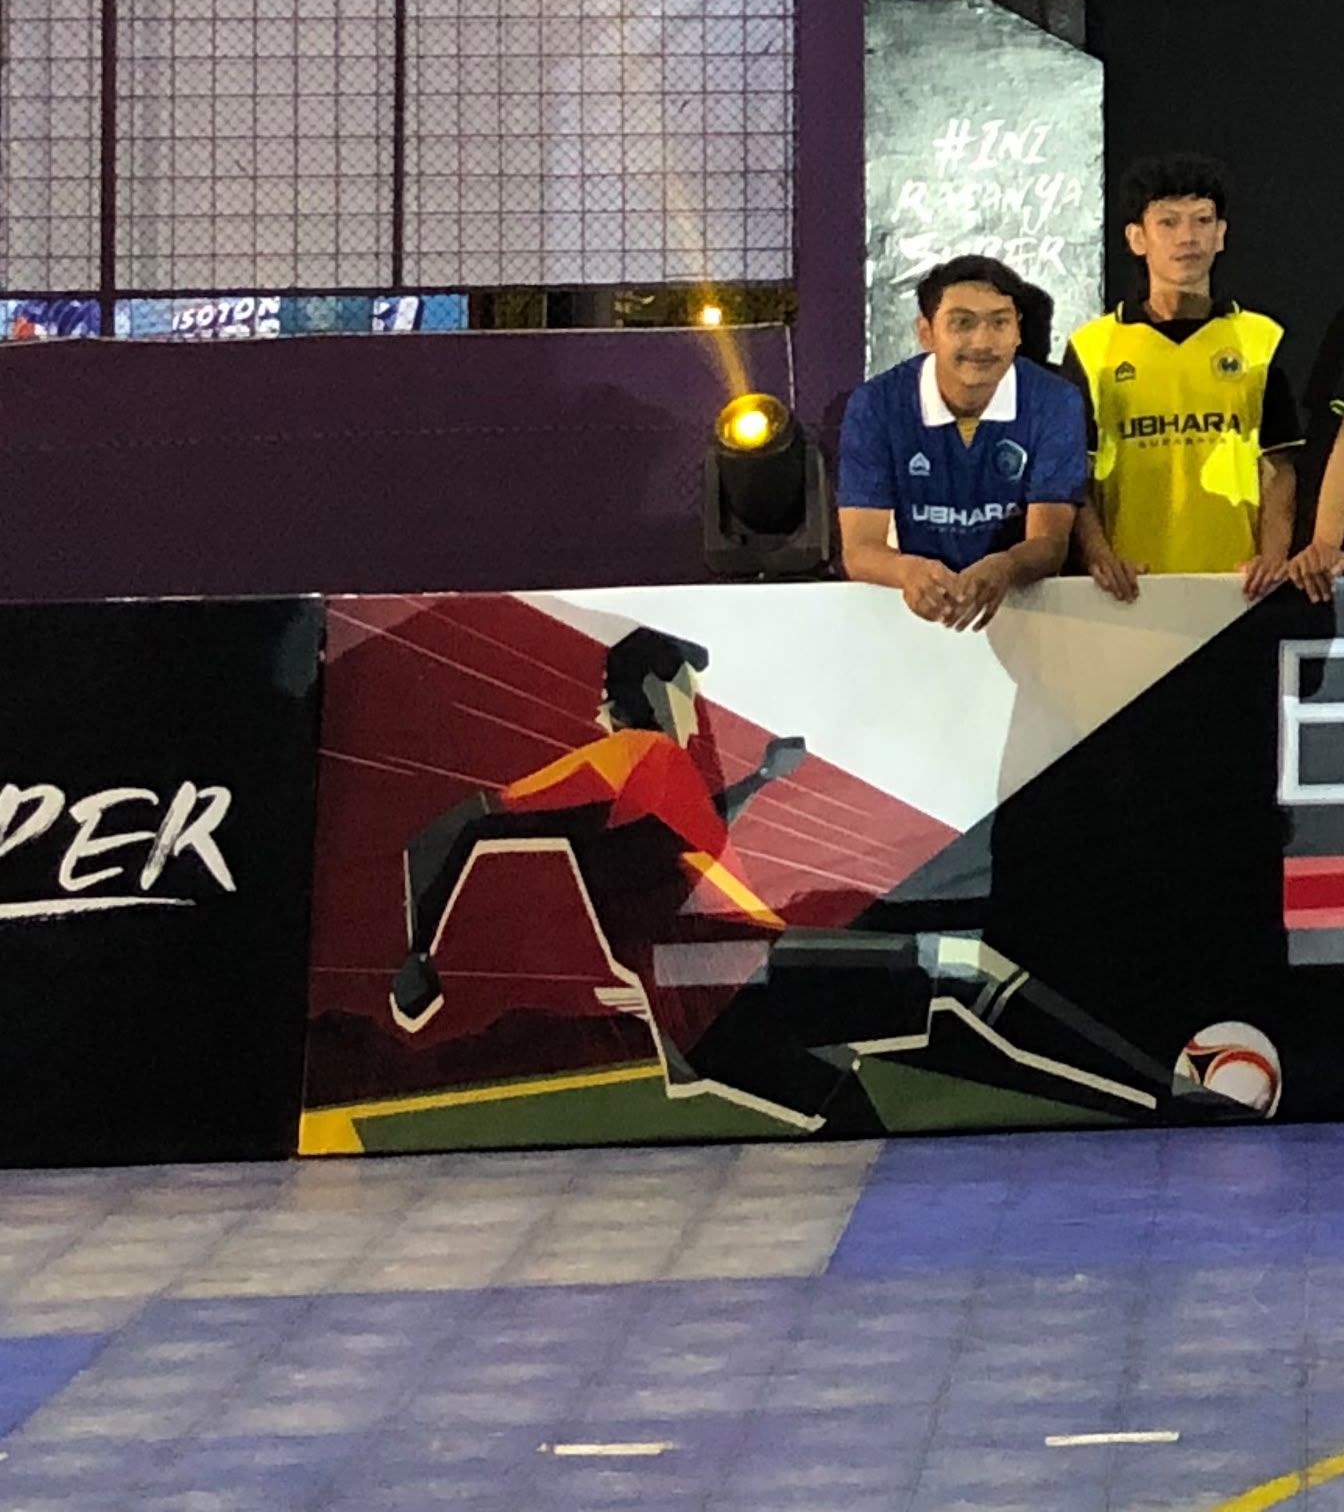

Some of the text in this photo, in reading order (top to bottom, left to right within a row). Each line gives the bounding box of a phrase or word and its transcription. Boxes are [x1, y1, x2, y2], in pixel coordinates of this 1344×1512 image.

[933, 118, 1050, 177] #INI
[1119, 412, 1242, 439] UBHARA
[911, 502, 1023, 526] UBHARA
[0, 780, 236, 893] PER
